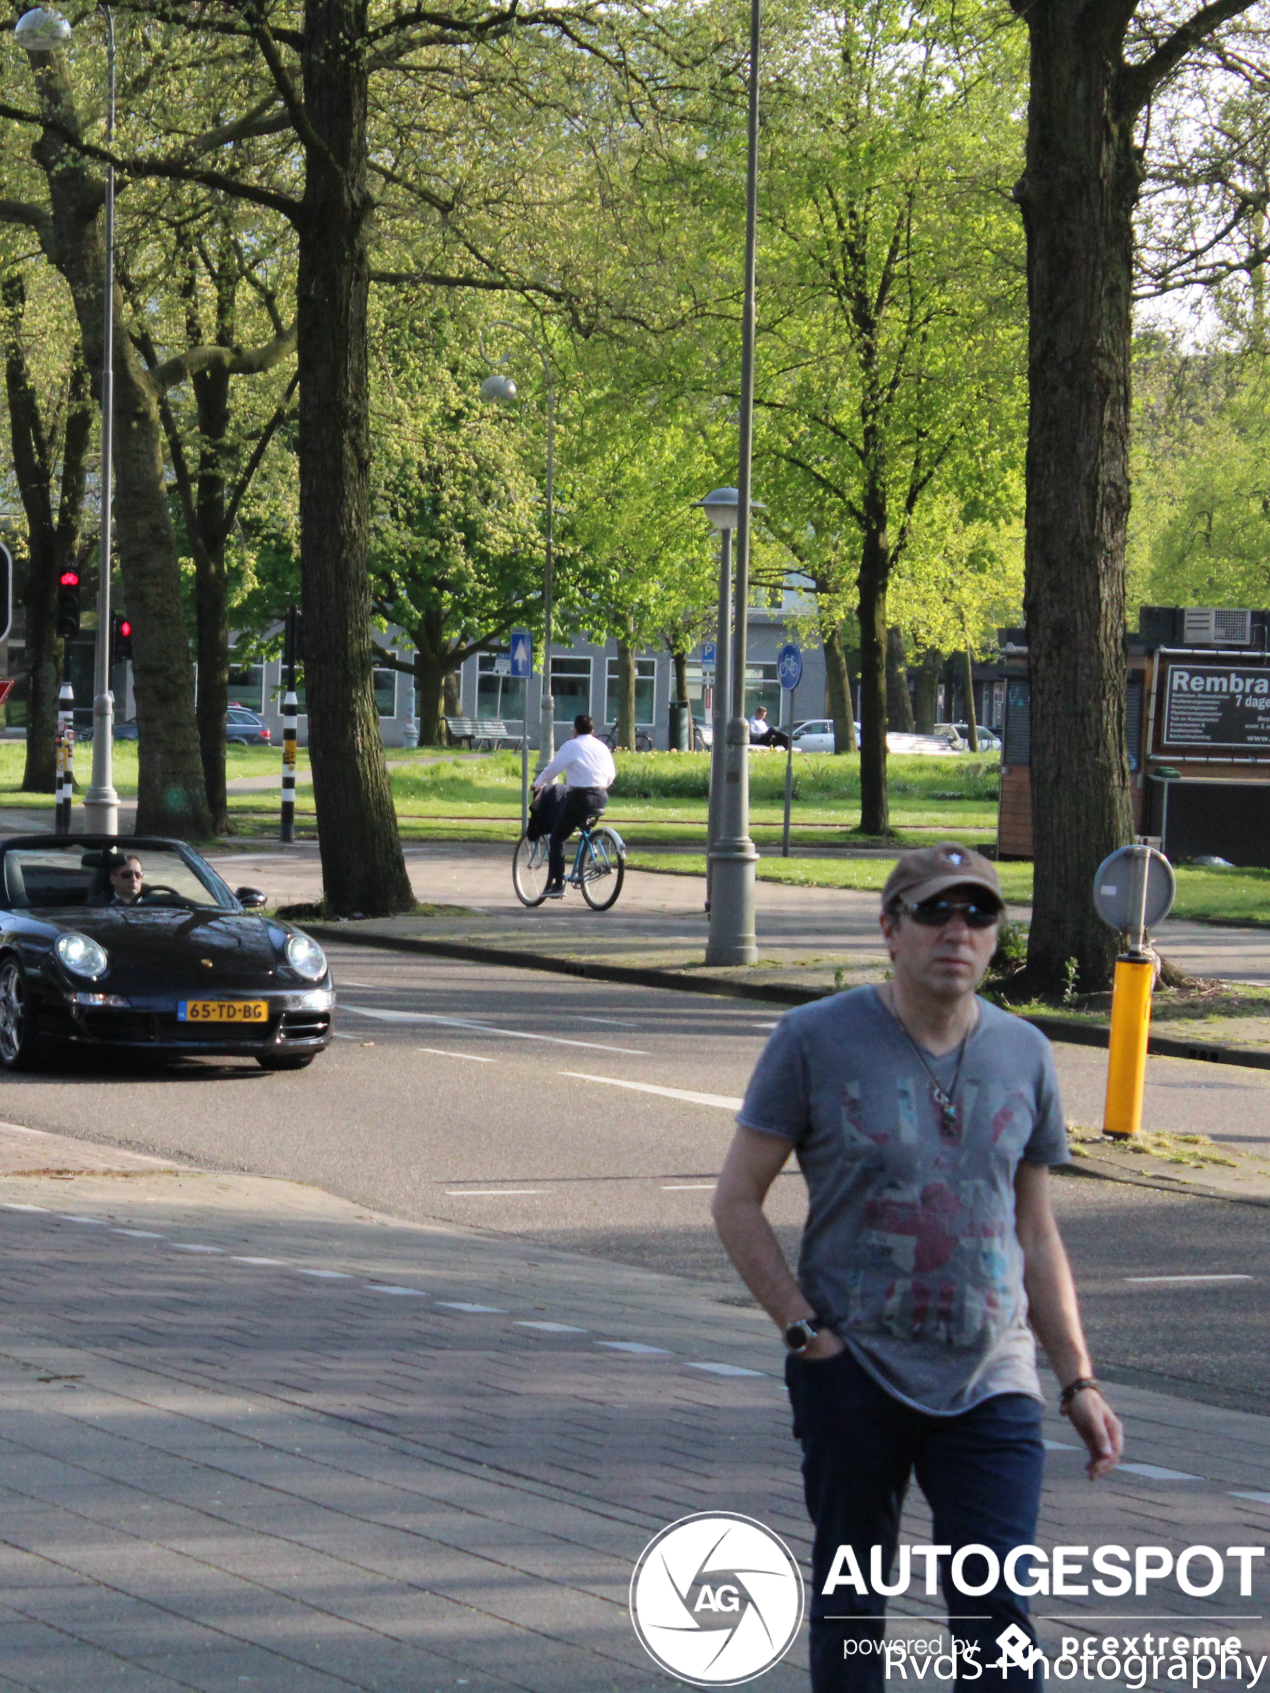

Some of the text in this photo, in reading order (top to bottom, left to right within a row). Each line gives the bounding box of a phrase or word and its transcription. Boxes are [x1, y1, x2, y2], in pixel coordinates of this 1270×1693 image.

[1172, 670, 1270, 694] Rembra
[1235, 694, 1243, 707] 7
[190, 1003, 262, 1018] 65-TD-BG
